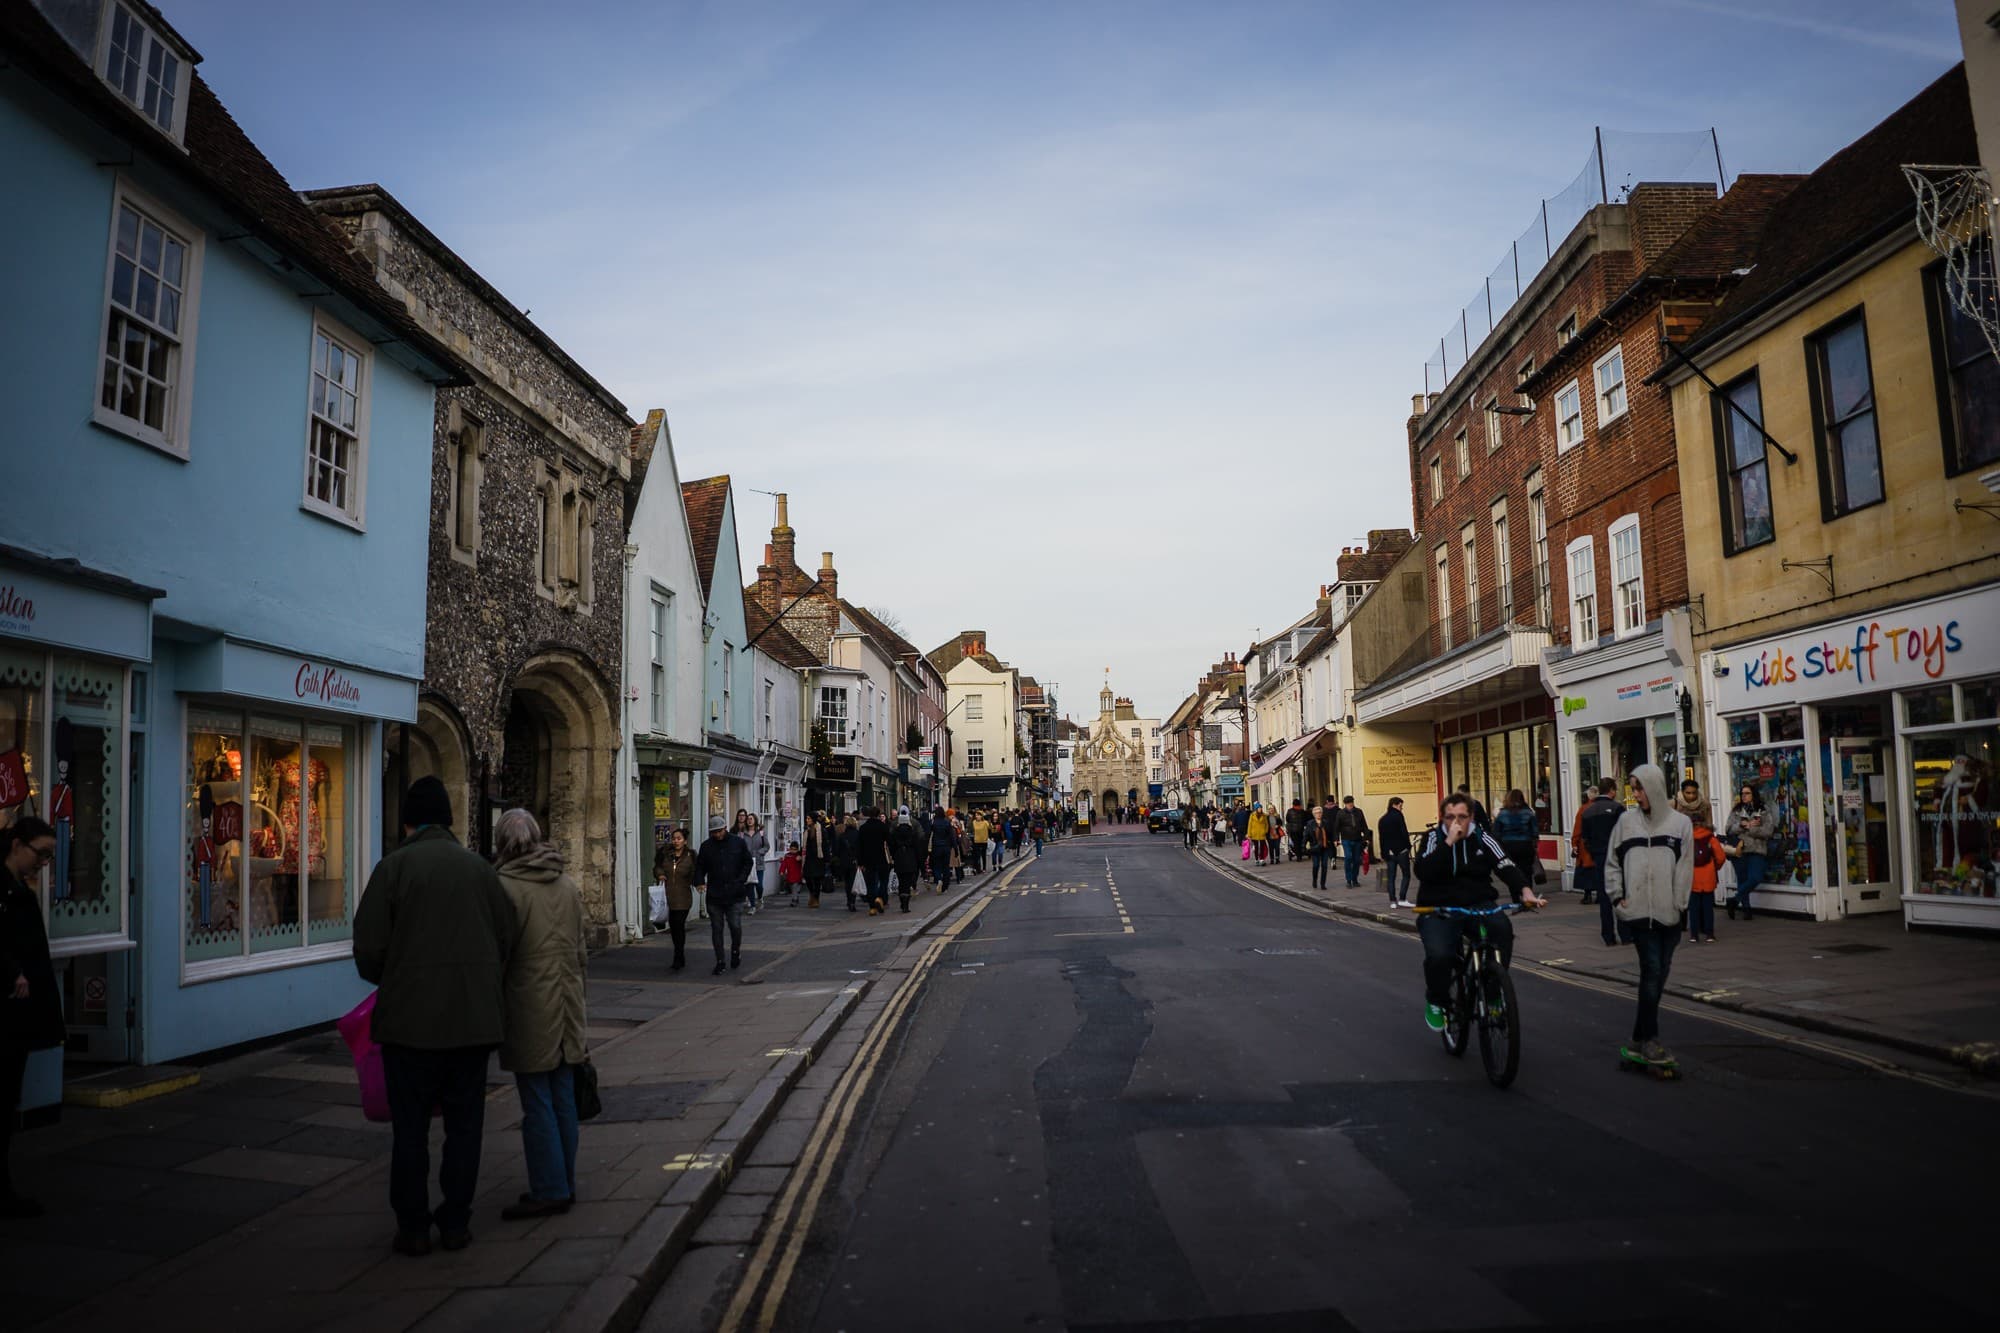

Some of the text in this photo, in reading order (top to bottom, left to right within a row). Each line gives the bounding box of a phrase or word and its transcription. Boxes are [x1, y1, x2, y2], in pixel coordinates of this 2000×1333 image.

[295, 663, 360, 702] Cath Kidston
[1744, 620, 1963, 691] Kids Stuff Toys
